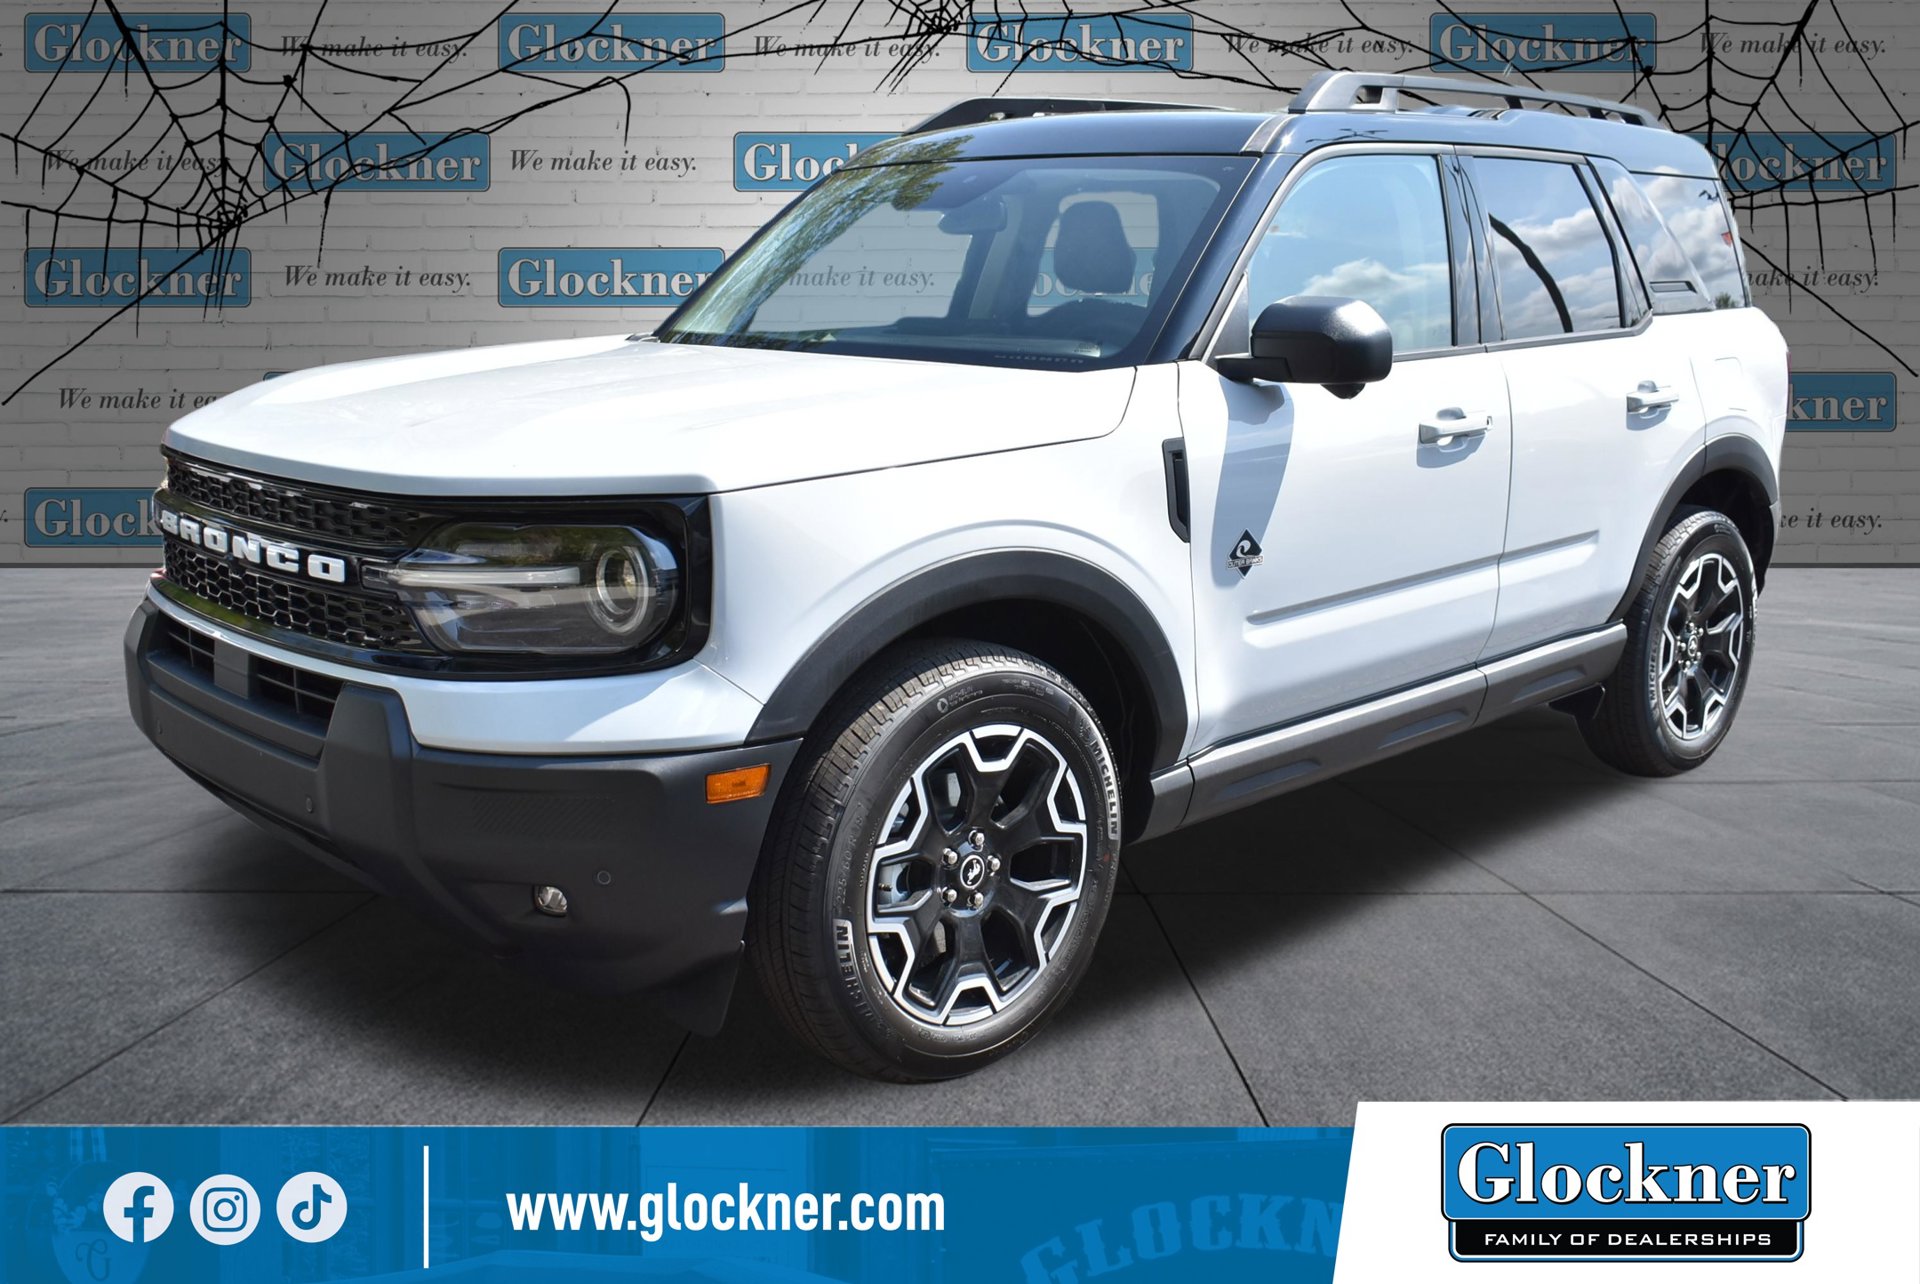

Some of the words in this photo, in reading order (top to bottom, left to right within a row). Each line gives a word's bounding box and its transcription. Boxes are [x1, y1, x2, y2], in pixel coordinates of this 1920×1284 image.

[34, 24, 242, 62] Glockner
[281, 35, 312, 57] W
[321, 35, 383, 57] make
[392, 35, 407, 57] it
[415, 42, 467, 63] easy.
[508, 24, 716, 62] Glockner
[754, 35, 786, 57] We
[794, 35, 856, 57] make
[864, 36, 880, 57] it
[888, 42, 940, 63] easy.
[976, 24, 1184, 62] Glockner
[1226, 32, 1259, 54] We
[1337, 33, 1353, 53] it
[1361, 39, 1413, 60] easy.
[1439, 24, 1648, 62] Glockner
[1700, 32, 1732, 53] We
[1740, 32, 1800, 53] make
[1810, 33, 1826, 53] it
[1834, 39, 1885, 60] easy.
[47, 150, 80, 170] We
[88, 150, 149, 170] make
[157, 150, 173, 170] it
[274, 143, 480, 181] Glockner
[510, 149, 543, 171] We
[551, 149, 613, 171] make
[621, 150, 637, 171] it
[644, 156, 697, 177] easy.
[34, 259, 242, 297] Glockner
[284, 265, 317, 286] We
[325, 265, 387, 286] make
[395, 265, 411, 286] it
[419, 272, 471, 293] easy.
[859, 266, 875, 286] it
[883, 271, 935, 294] easy.
[1803, 265, 1819, 286] it
[1827, 272, 1879, 294] easy.
[58, 388, 92, 409] We
[100, 388, 160, 409] make
[169, 388, 185, 409] it
[1807, 508, 1822, 528] it
[1831, 514, 1882, 536] easy.
[160, 509, 346, 584] BRONCO
[1090, 739, 1118, 835] MICHELIN
